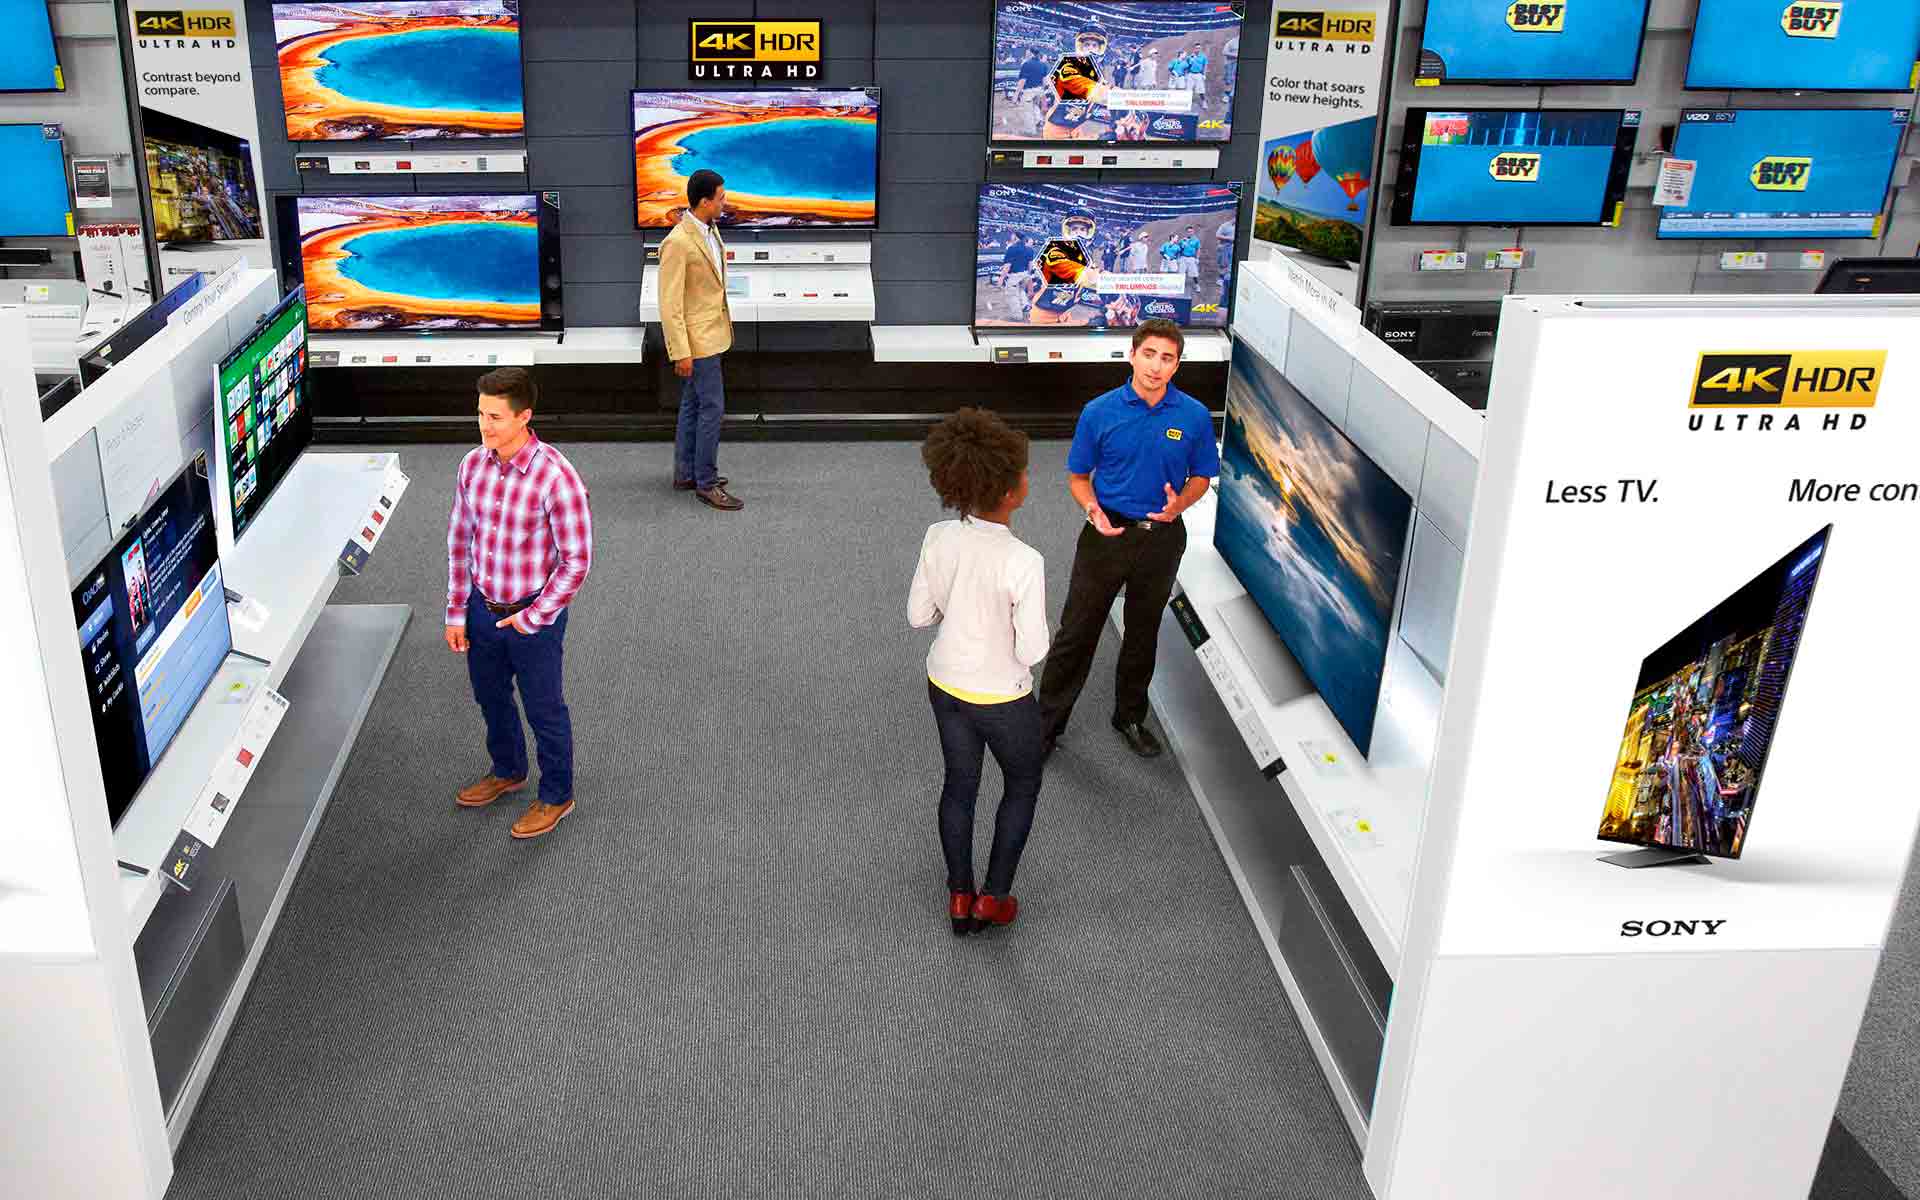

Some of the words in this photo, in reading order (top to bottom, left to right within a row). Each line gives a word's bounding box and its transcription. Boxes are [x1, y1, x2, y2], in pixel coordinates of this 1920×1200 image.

[1005, 5, 1032, 13] SONY
[1513, 3, 1564, 15] BEST
[1788, 6, 1840, 19] BEST
[139, 17, 183, 31] 4K
[187, 16, 233, 30] HDR
[1278, 18, 1322, 31] 4K
[1326, 18, 1372, 33] HDR
[1514, 15, 1557, 26] BUY
[1787, 19, 1832, 31] BUY
[139, 39, 201, 49] ULTRA
[211, 39, 236, 49] HD
[698, 33, 752, 50] 4K
[760, 33, 815, 50] HDR
[1274, 41, 1335, 53] ULTRA
[1345, 43, 1372, 54] HD
[142, 71, 193, 83] Contrast
[194, 71, 241, 84] beyond
[695, 65, 773, 78] ULTRA
[786, 65, 817, 78] HD
[144, 85, 200, 97] compare.
[1270, 76, 1301, 90] Color
[1303, 78, 1328, 92] that
[1330, 82, 1365, 95] soars
[1269, 91, 1282, 102] to
[1284, 93, 1311, 104] new
[1312, 93, 1364, 110] heights.
[1199, 120, 1224, 129] 4K
[1495, 157, 1539, 168] BEST
[1759, 162, 1810, 174] BEST
[1495, 166, 1533, 177] BUY
[1758, 173, 1802, 185] BUY
[988, 189, 1017, 197] SONY
[1191, 303, 1218, 313] 4K
[1700, 367, 1783, 393] 4K
[1791, 367, 1876, 393] HDR
[1688, 414, 1801, 431] ULTRA
[1822, 413, 1867, 431] HD
[1545, 480, 1608, 503] Less
[1617, 479, 1659, 503] TV.
[1788, 478, 1861, 502] More
[1870, 482, 1920, 502] con
[1620, 919, 1727, 937] SONY
